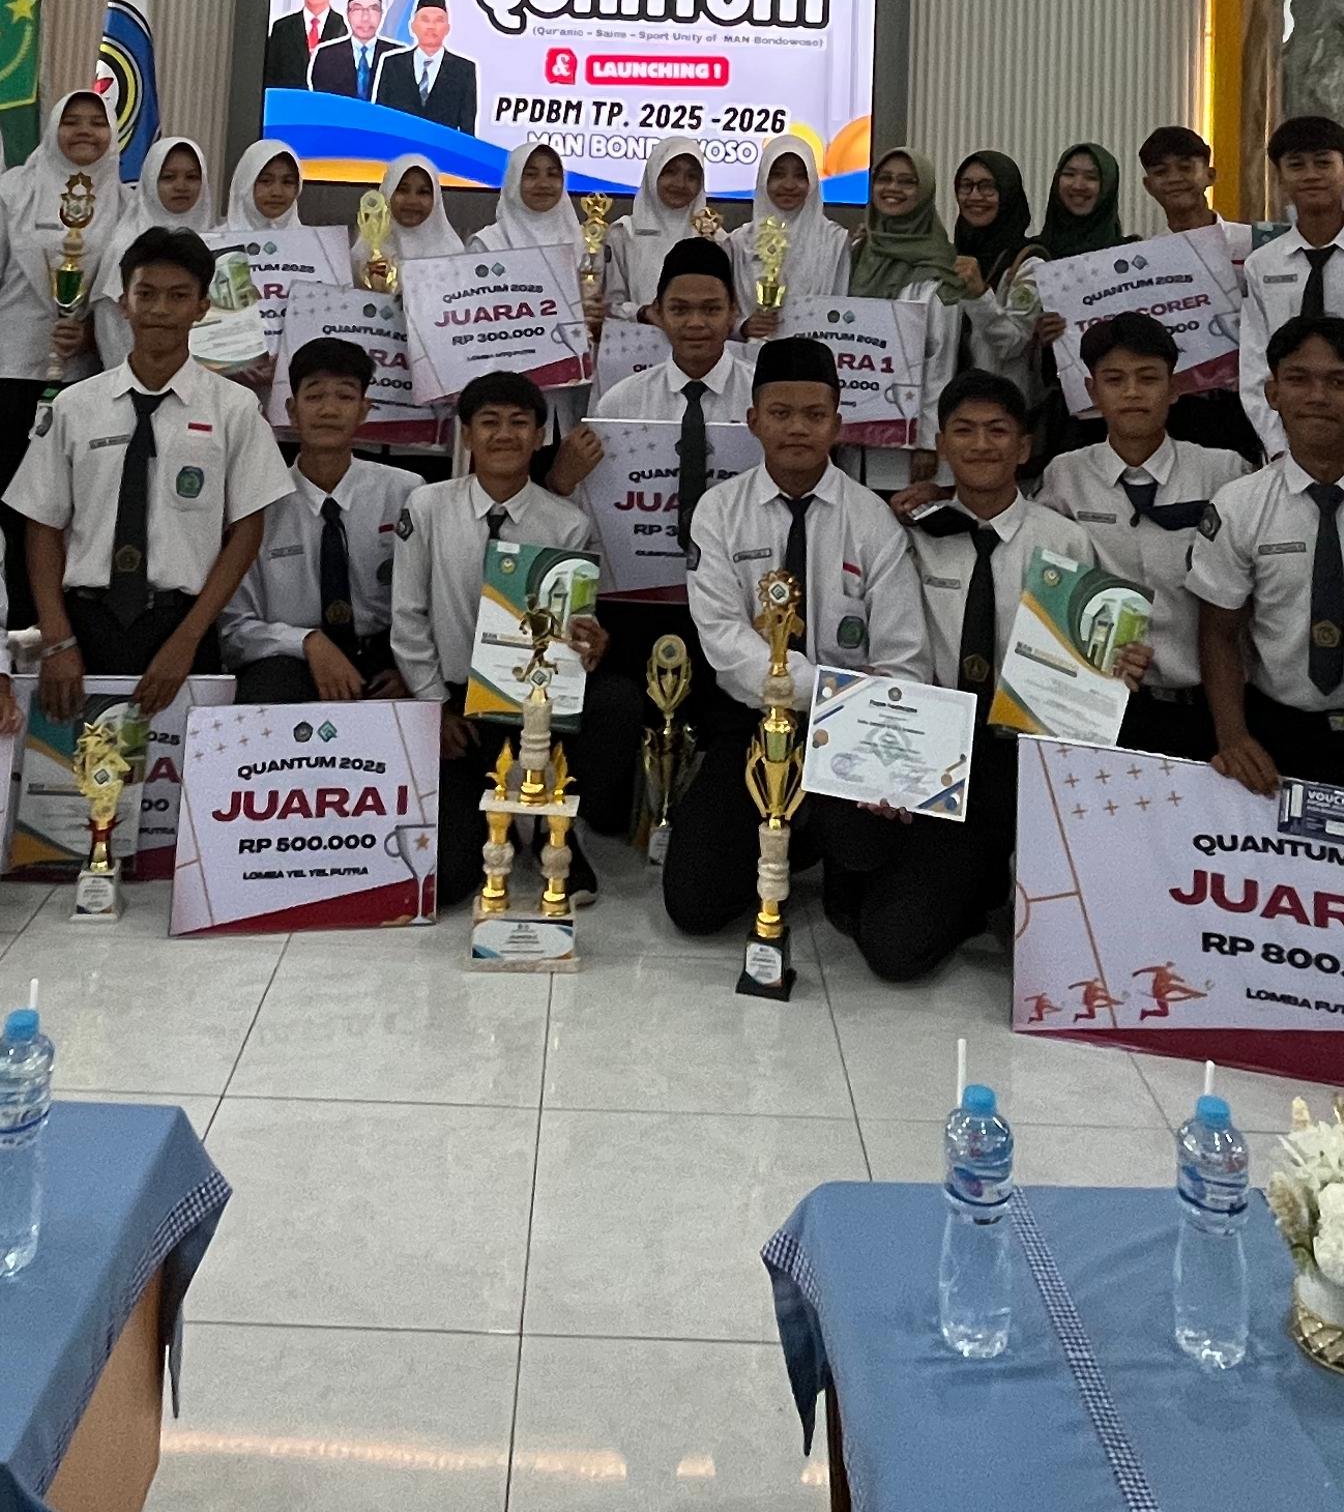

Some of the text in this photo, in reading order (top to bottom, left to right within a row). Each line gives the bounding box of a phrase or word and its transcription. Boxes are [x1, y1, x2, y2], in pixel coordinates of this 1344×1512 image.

[724, 35, 750, 45] MAN
[551, 52, 571, 77] &
[592, 61, 710, 80] LAUNCHING
[495, 96, 585, 125] PPDBM
[592, 100, 630, 128] TP.
[639, 103, 704, 130] 2025
[1082, 278, 1154, 306] QUANTUM
[434, 299, 558, 328] JUARA 2
[477, 326, 545, 344] 300.000
[880, 356, 895, 374] 1
[633, 523, 662, 536] RP
[237, 756, 386, 780] QUANTUM 2025
[211, 784, 409, 822] JUARA I
[238, 833, 377, 855] RP 500.000
[1201, 931, 1255, 957] RP
[1245, 987, 1312, 1011] LOMBA
